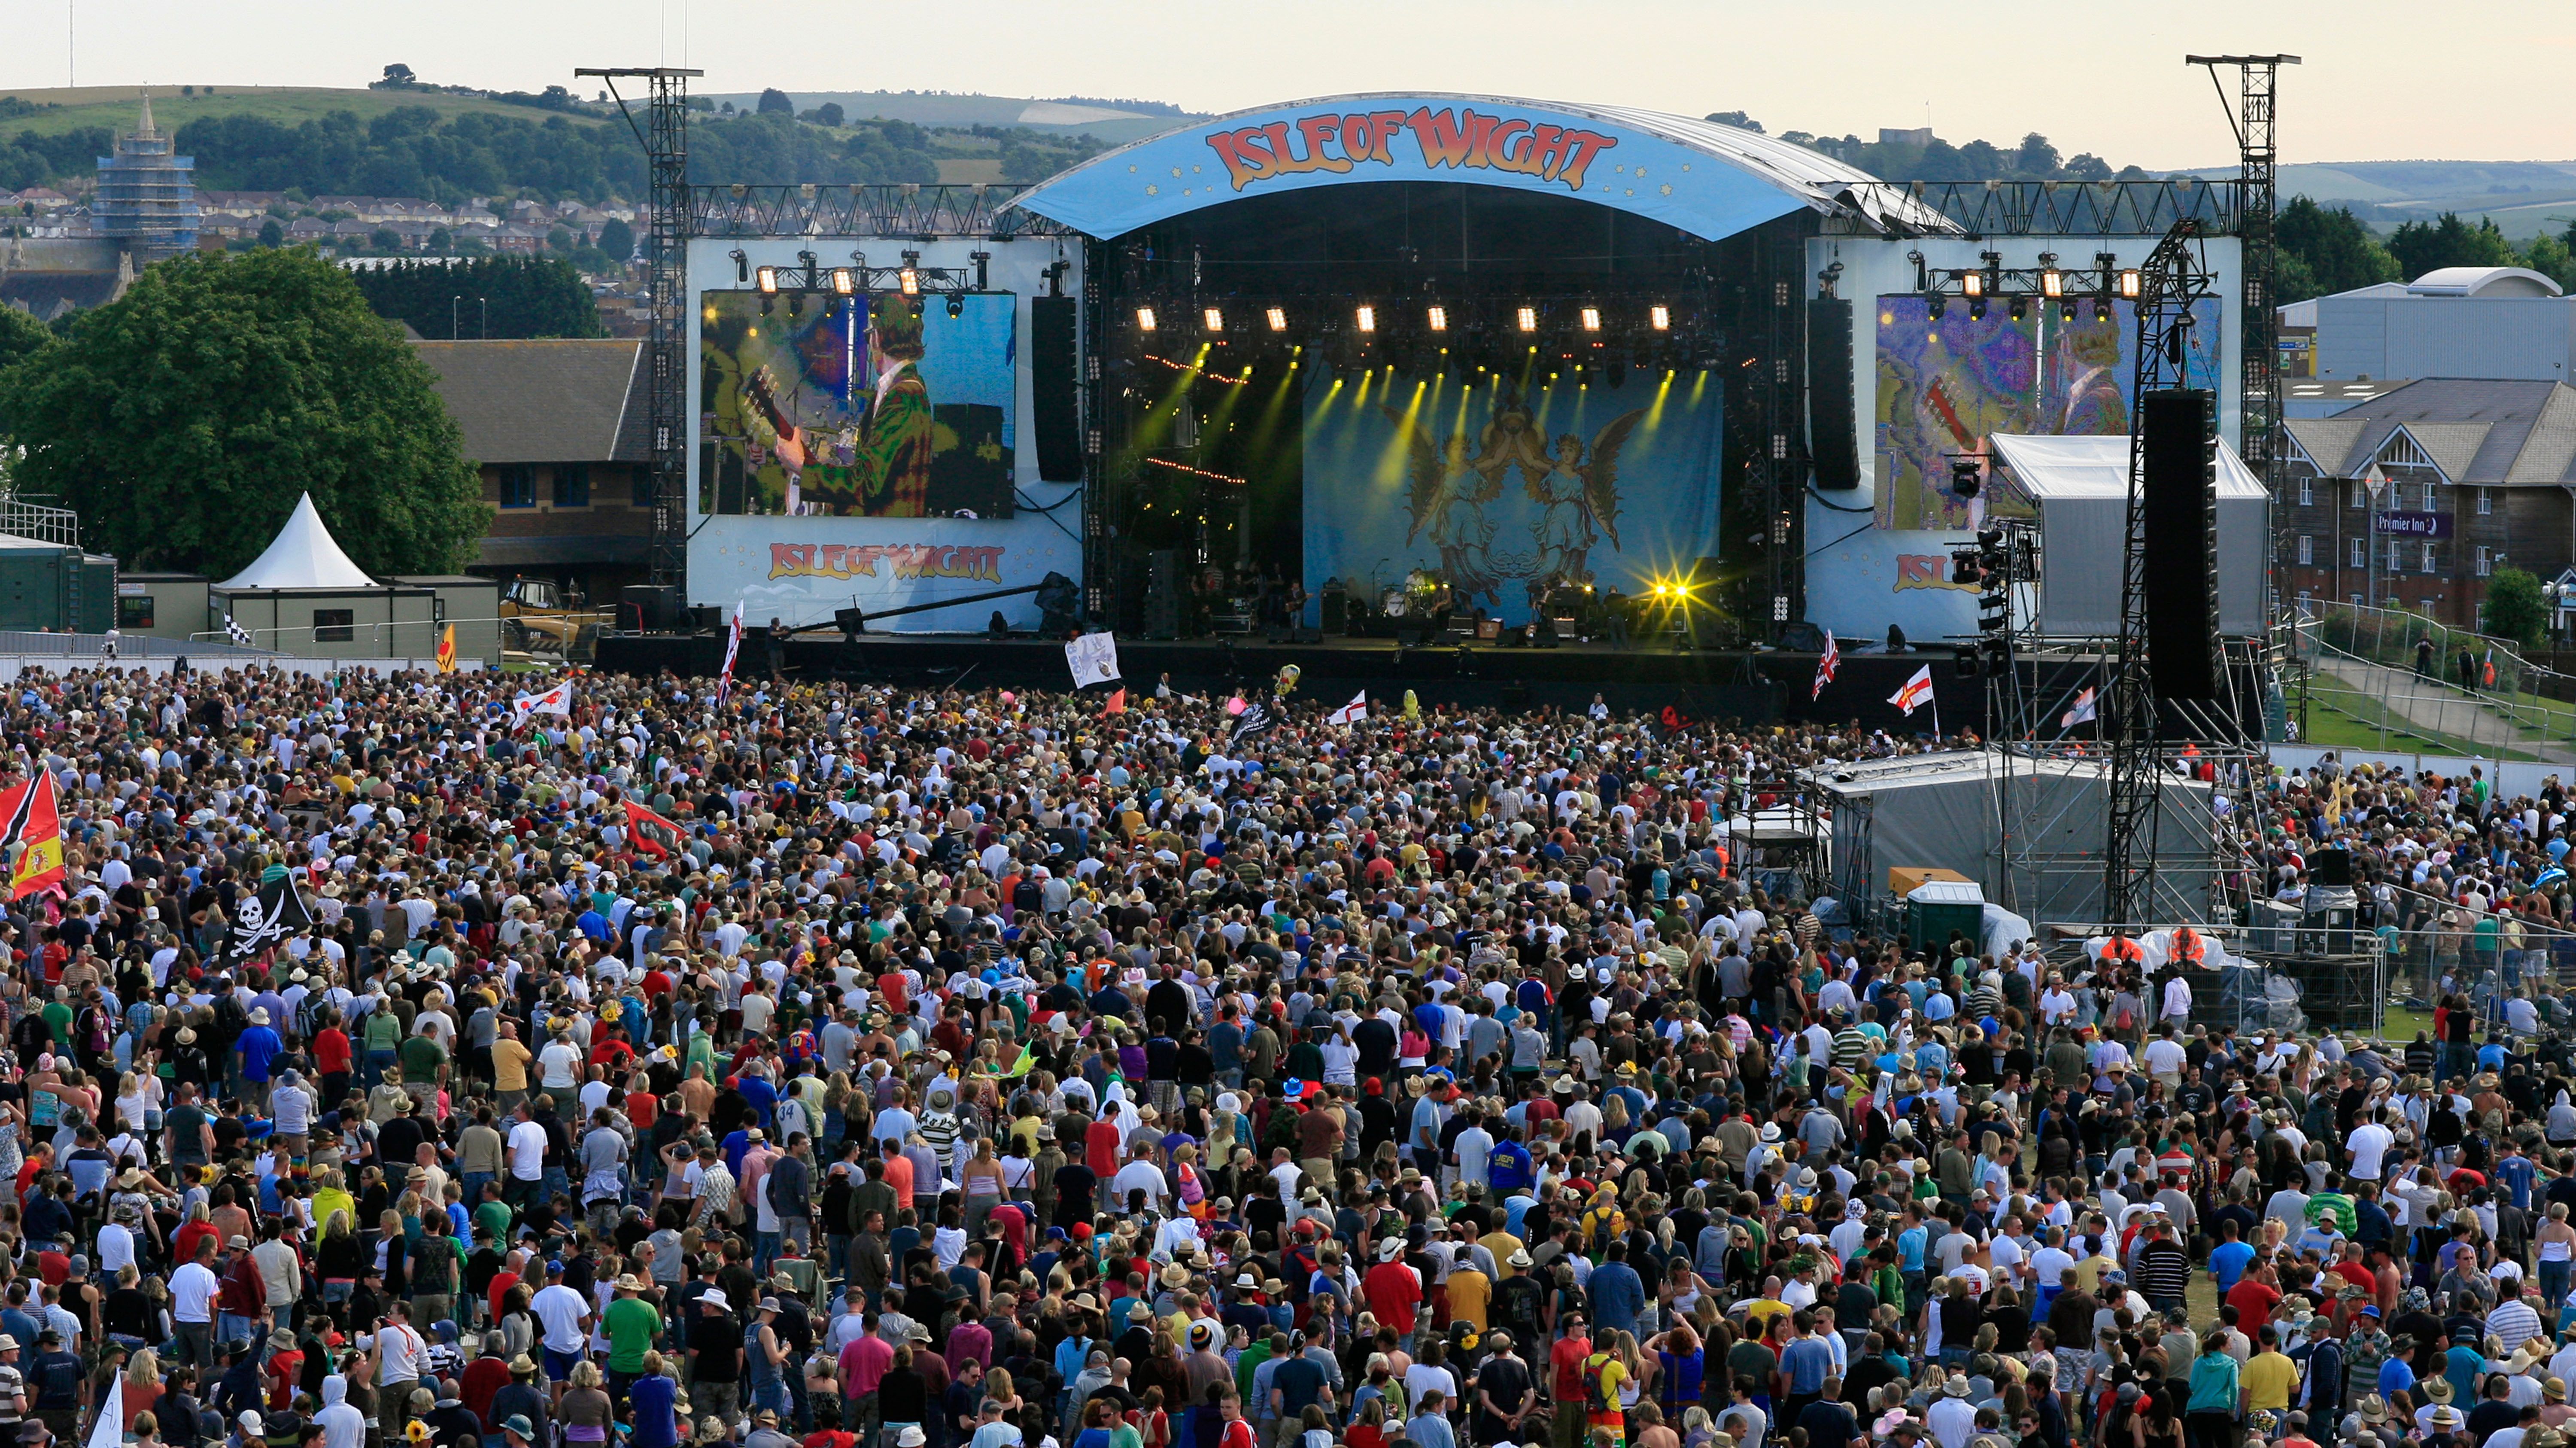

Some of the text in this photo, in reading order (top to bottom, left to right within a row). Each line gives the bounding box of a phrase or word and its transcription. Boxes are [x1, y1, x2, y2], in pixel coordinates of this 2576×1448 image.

[1206, 105, 1618, 192] ISLE OF WIGHT
[2379, 515, 2425, 532] Premier Inn
[768, 543, 1005, 584] ISLE OF WIGHT
[1893, 554, 1984, 594] ISL
[1097, 964, 1110, 976] 7
[790, 1036, 802, 1048] 10
[779, 1104, 794, 1121] 34
[1495, 1153, 1515, 1165] UEA
